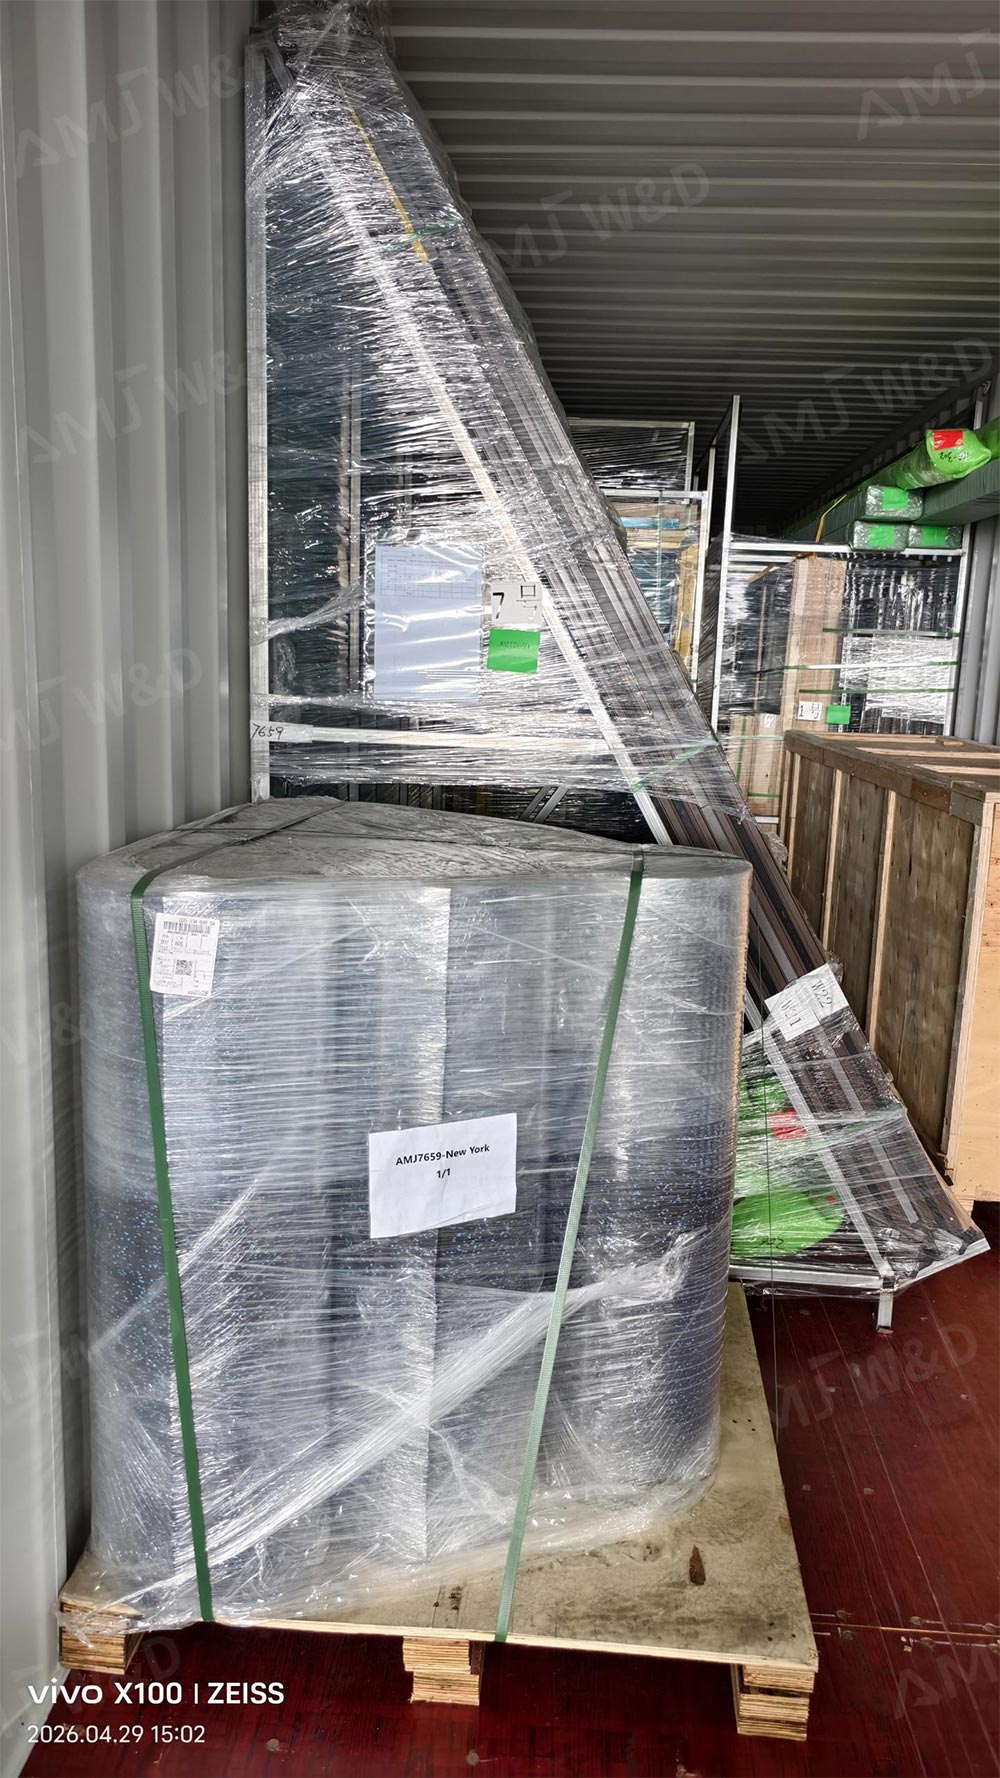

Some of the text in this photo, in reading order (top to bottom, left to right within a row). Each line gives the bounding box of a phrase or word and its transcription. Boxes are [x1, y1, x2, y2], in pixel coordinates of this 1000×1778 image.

[251, 723, 284, 740] 7659
[395, 1144, 490, 1166] AMJ7659-New York
[436, 1168, 451, 1179] 1/1
